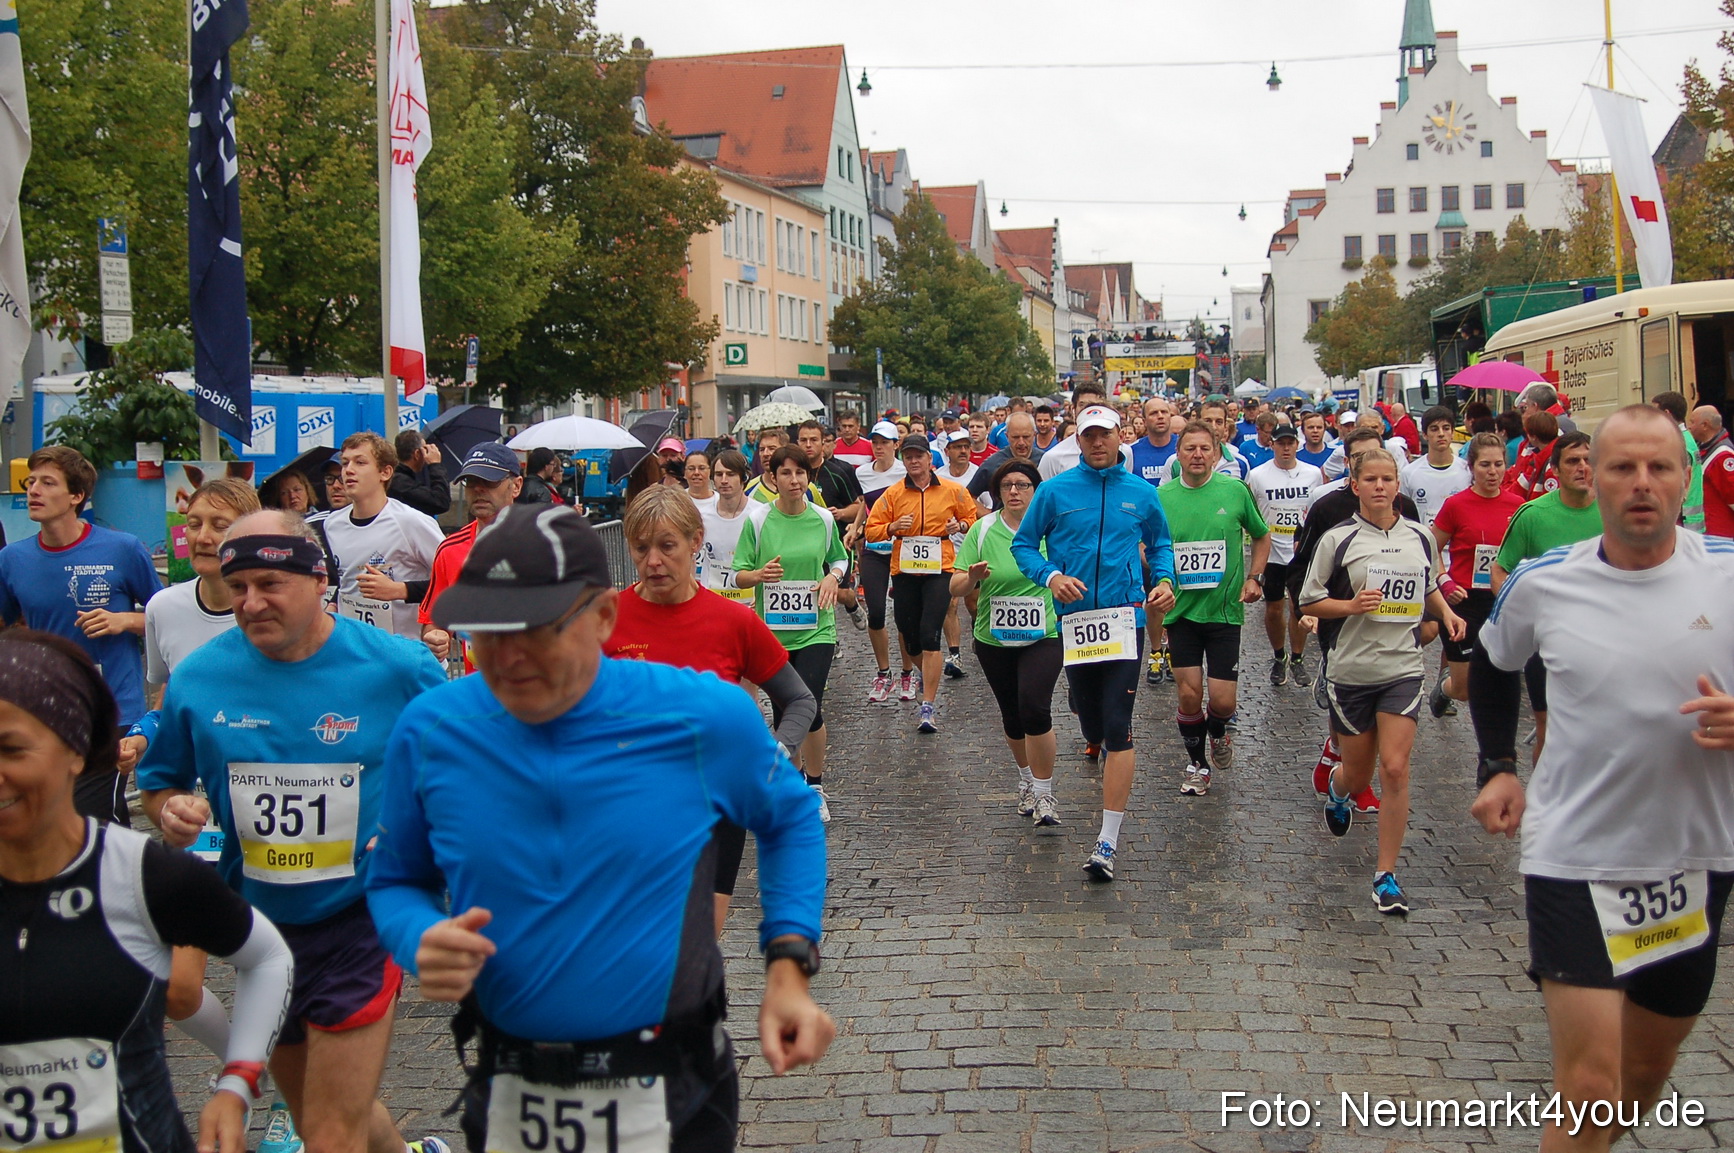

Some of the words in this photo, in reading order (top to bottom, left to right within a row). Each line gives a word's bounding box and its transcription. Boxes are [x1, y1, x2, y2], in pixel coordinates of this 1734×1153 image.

[728, 345, 744, 362] D
[1564, 339, 1614, 367] Bayerisches
[1135, 360, 1165, 369] START
[1563, 370, 1587, 388] Rotes
[1566, 394, 1586, 411] reuz
[1265, 487, 1309, 501] THULE
[1276, 512, 1299, 526] 253
[913, 545, 929, 559] 95
[1180, 552, 1221, 571] 2872
[1479, 556, 1498, 572] 2
[1185, 574, 1216, 583] Wolfgang
[1380, 579, 1416, 600] 469
[770, 593, 813, 611] 2834
[1380, 605, 1408, 614] Claudia
[355, 610, 375, 626] 76
[995, 608, 1040, 627] 2830
[1063, 617, 1081, 625] PARTL
[1081, 614, 1110, 622] Neumarkt
[1002, 631, 1033, 640] Gabriele
[1074, 622, 1110, 645] 508
[1077, 647, 1109, 658] Thorsten
[231, 775, 271, 786] PARTL
[275, 776, 335, 787] Neumarkt
[253, 793, 326, 837] 351
[210, 836, 223, 848] Be
[267, 849, 314, 869] Georg
[1618, 871, 1688, 926] 355
[1634, 926, 1681, 949] dorner
[0, 1082, 79, 1144] 33
[520, 1093, 619, 1153] 551
